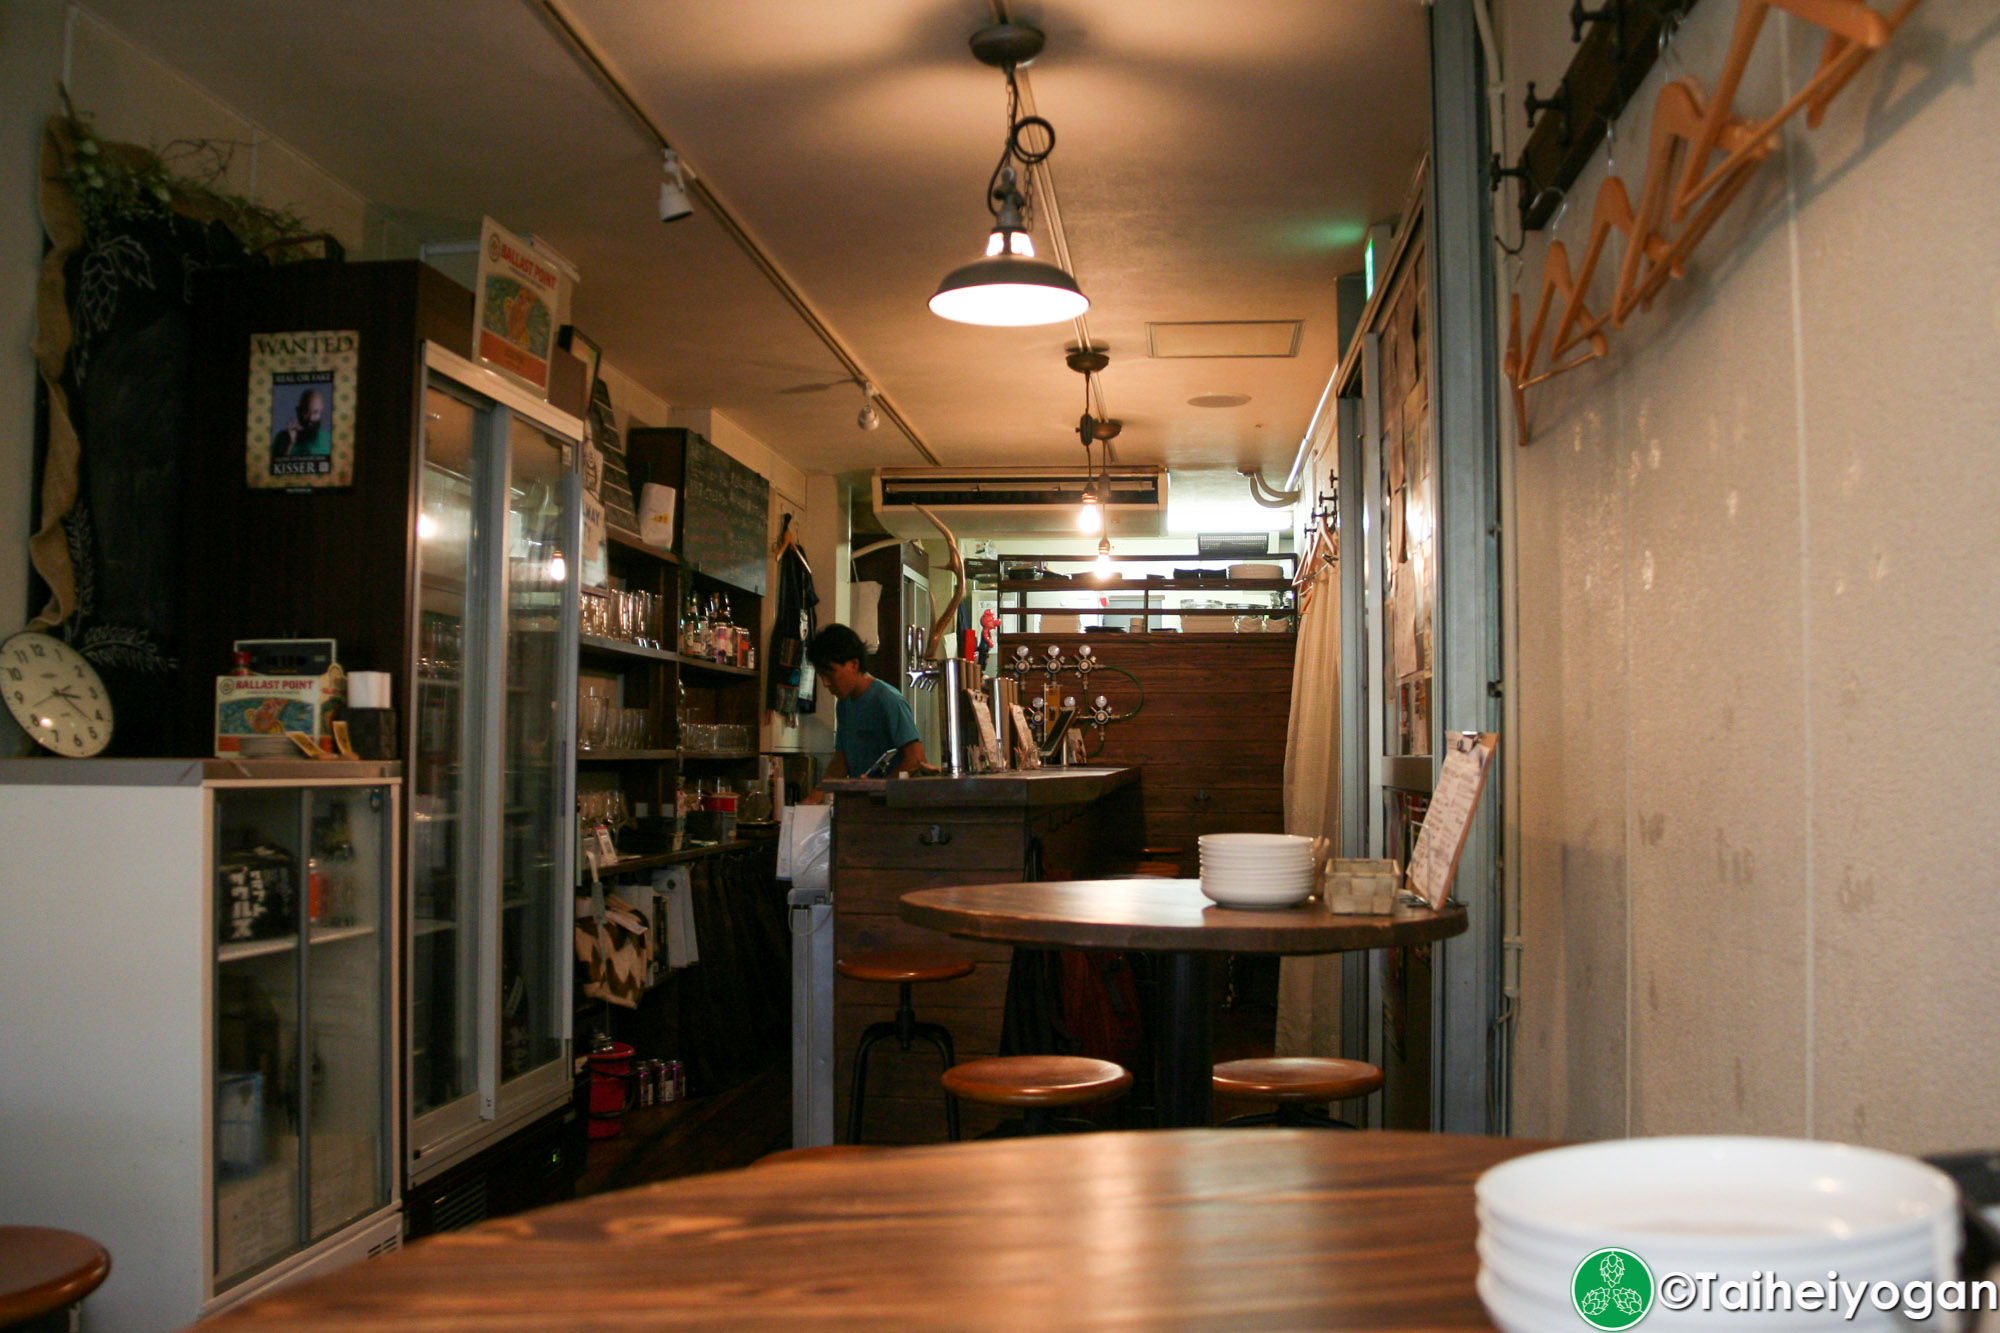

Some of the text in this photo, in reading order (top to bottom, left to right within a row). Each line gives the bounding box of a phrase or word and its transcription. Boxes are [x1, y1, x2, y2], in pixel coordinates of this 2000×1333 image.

[501, 243, 533, 276] BALLAST
[534, 266, 557, 288] POINT
[256, 336, 353, 354] WANTED
[273, 461, 316, 474] KISSER
[14, 649, 29, 664] 11
[29, 643, 45, 657] 12
[54, 648, 63, 662] 1
[6, 667, 23, 681] 10
[74, 664, 85, 678] 2
[236, 679, 280, 690] BALLAST
[282, 679, 314, 690] POINT
[14, 690, 24, 704] 9
[88, 686, 98, 700] 3
[30, 713, 40, 727] 8
[95, 709, 104, 721] 4
[50, 729, 59, 743] 7
[73, 733, 83, 747] 6
[88, 726, 98, 740] 5
